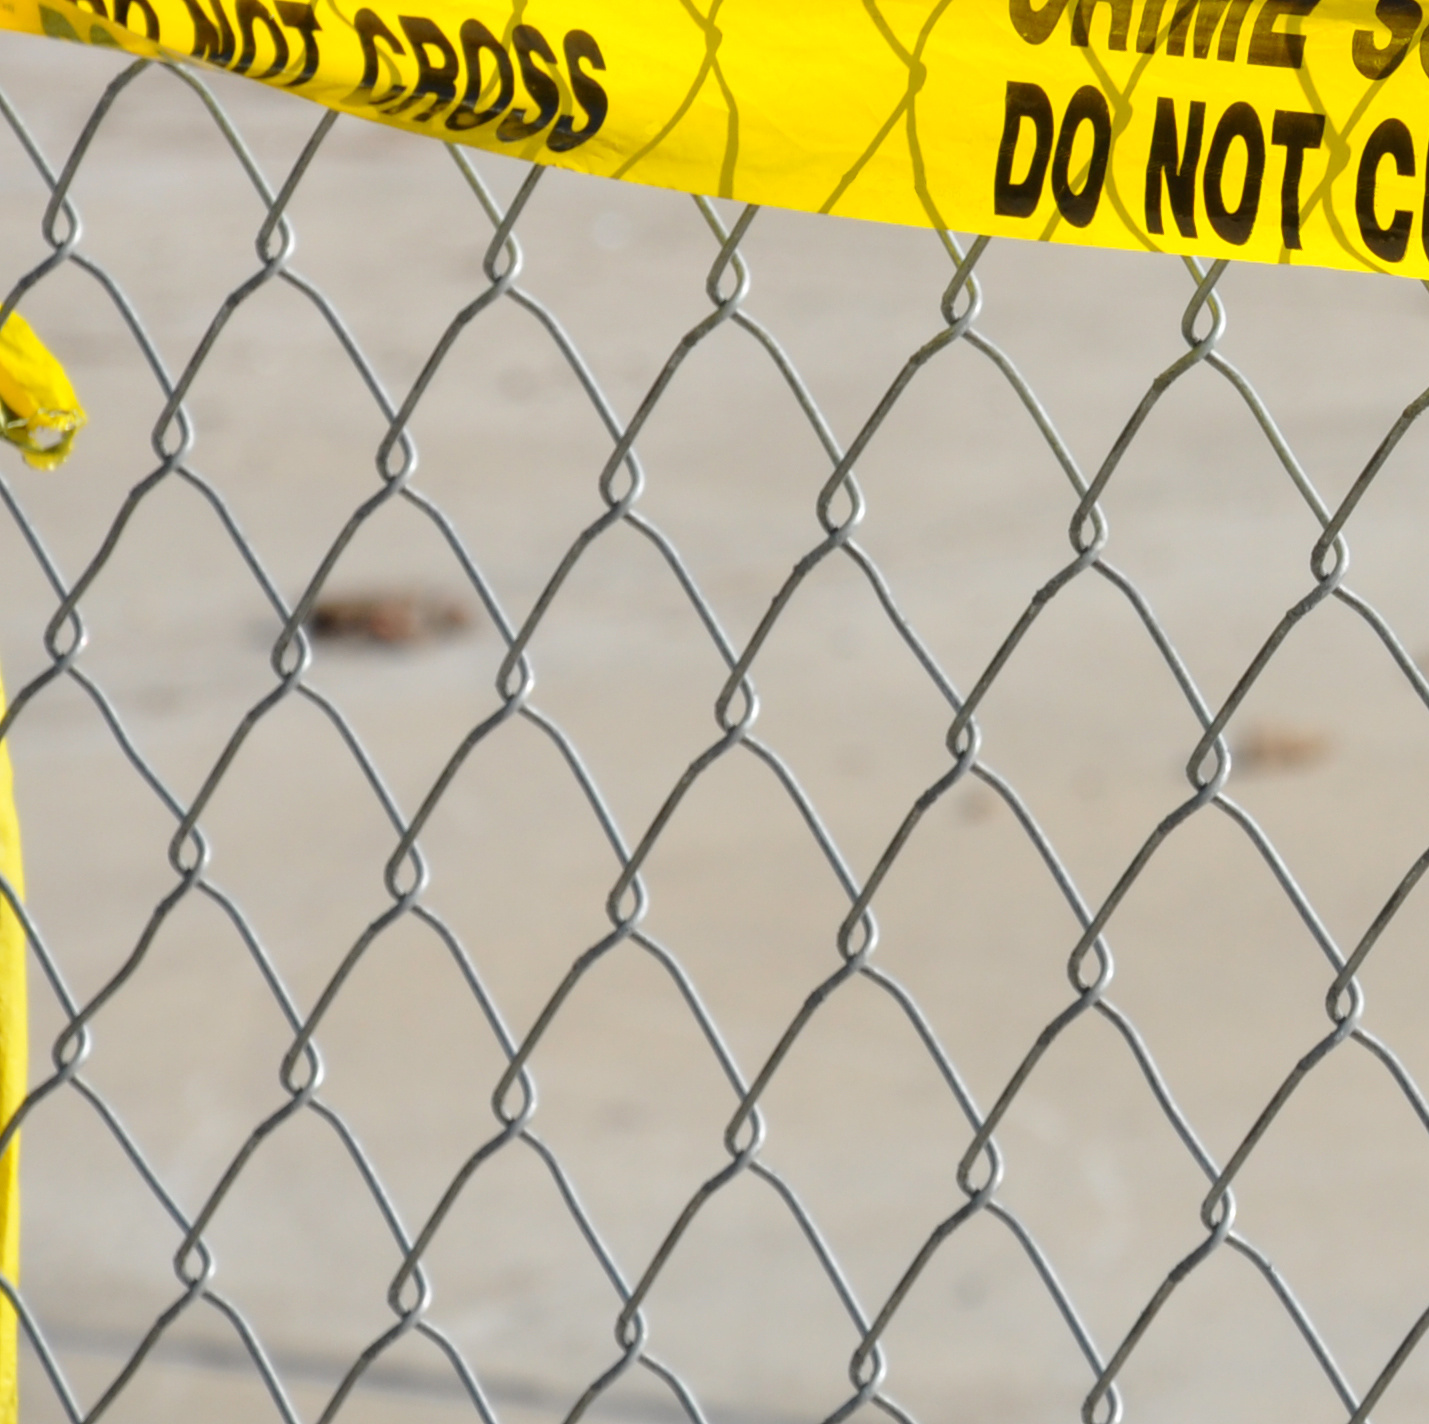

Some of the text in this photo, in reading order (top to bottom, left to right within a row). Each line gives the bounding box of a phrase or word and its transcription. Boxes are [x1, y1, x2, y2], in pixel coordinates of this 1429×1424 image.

[354, 7, 608, 153] CROSS
[994, 81, 1113, 228] DO
[1144, 97, 1326, 251] NOT
